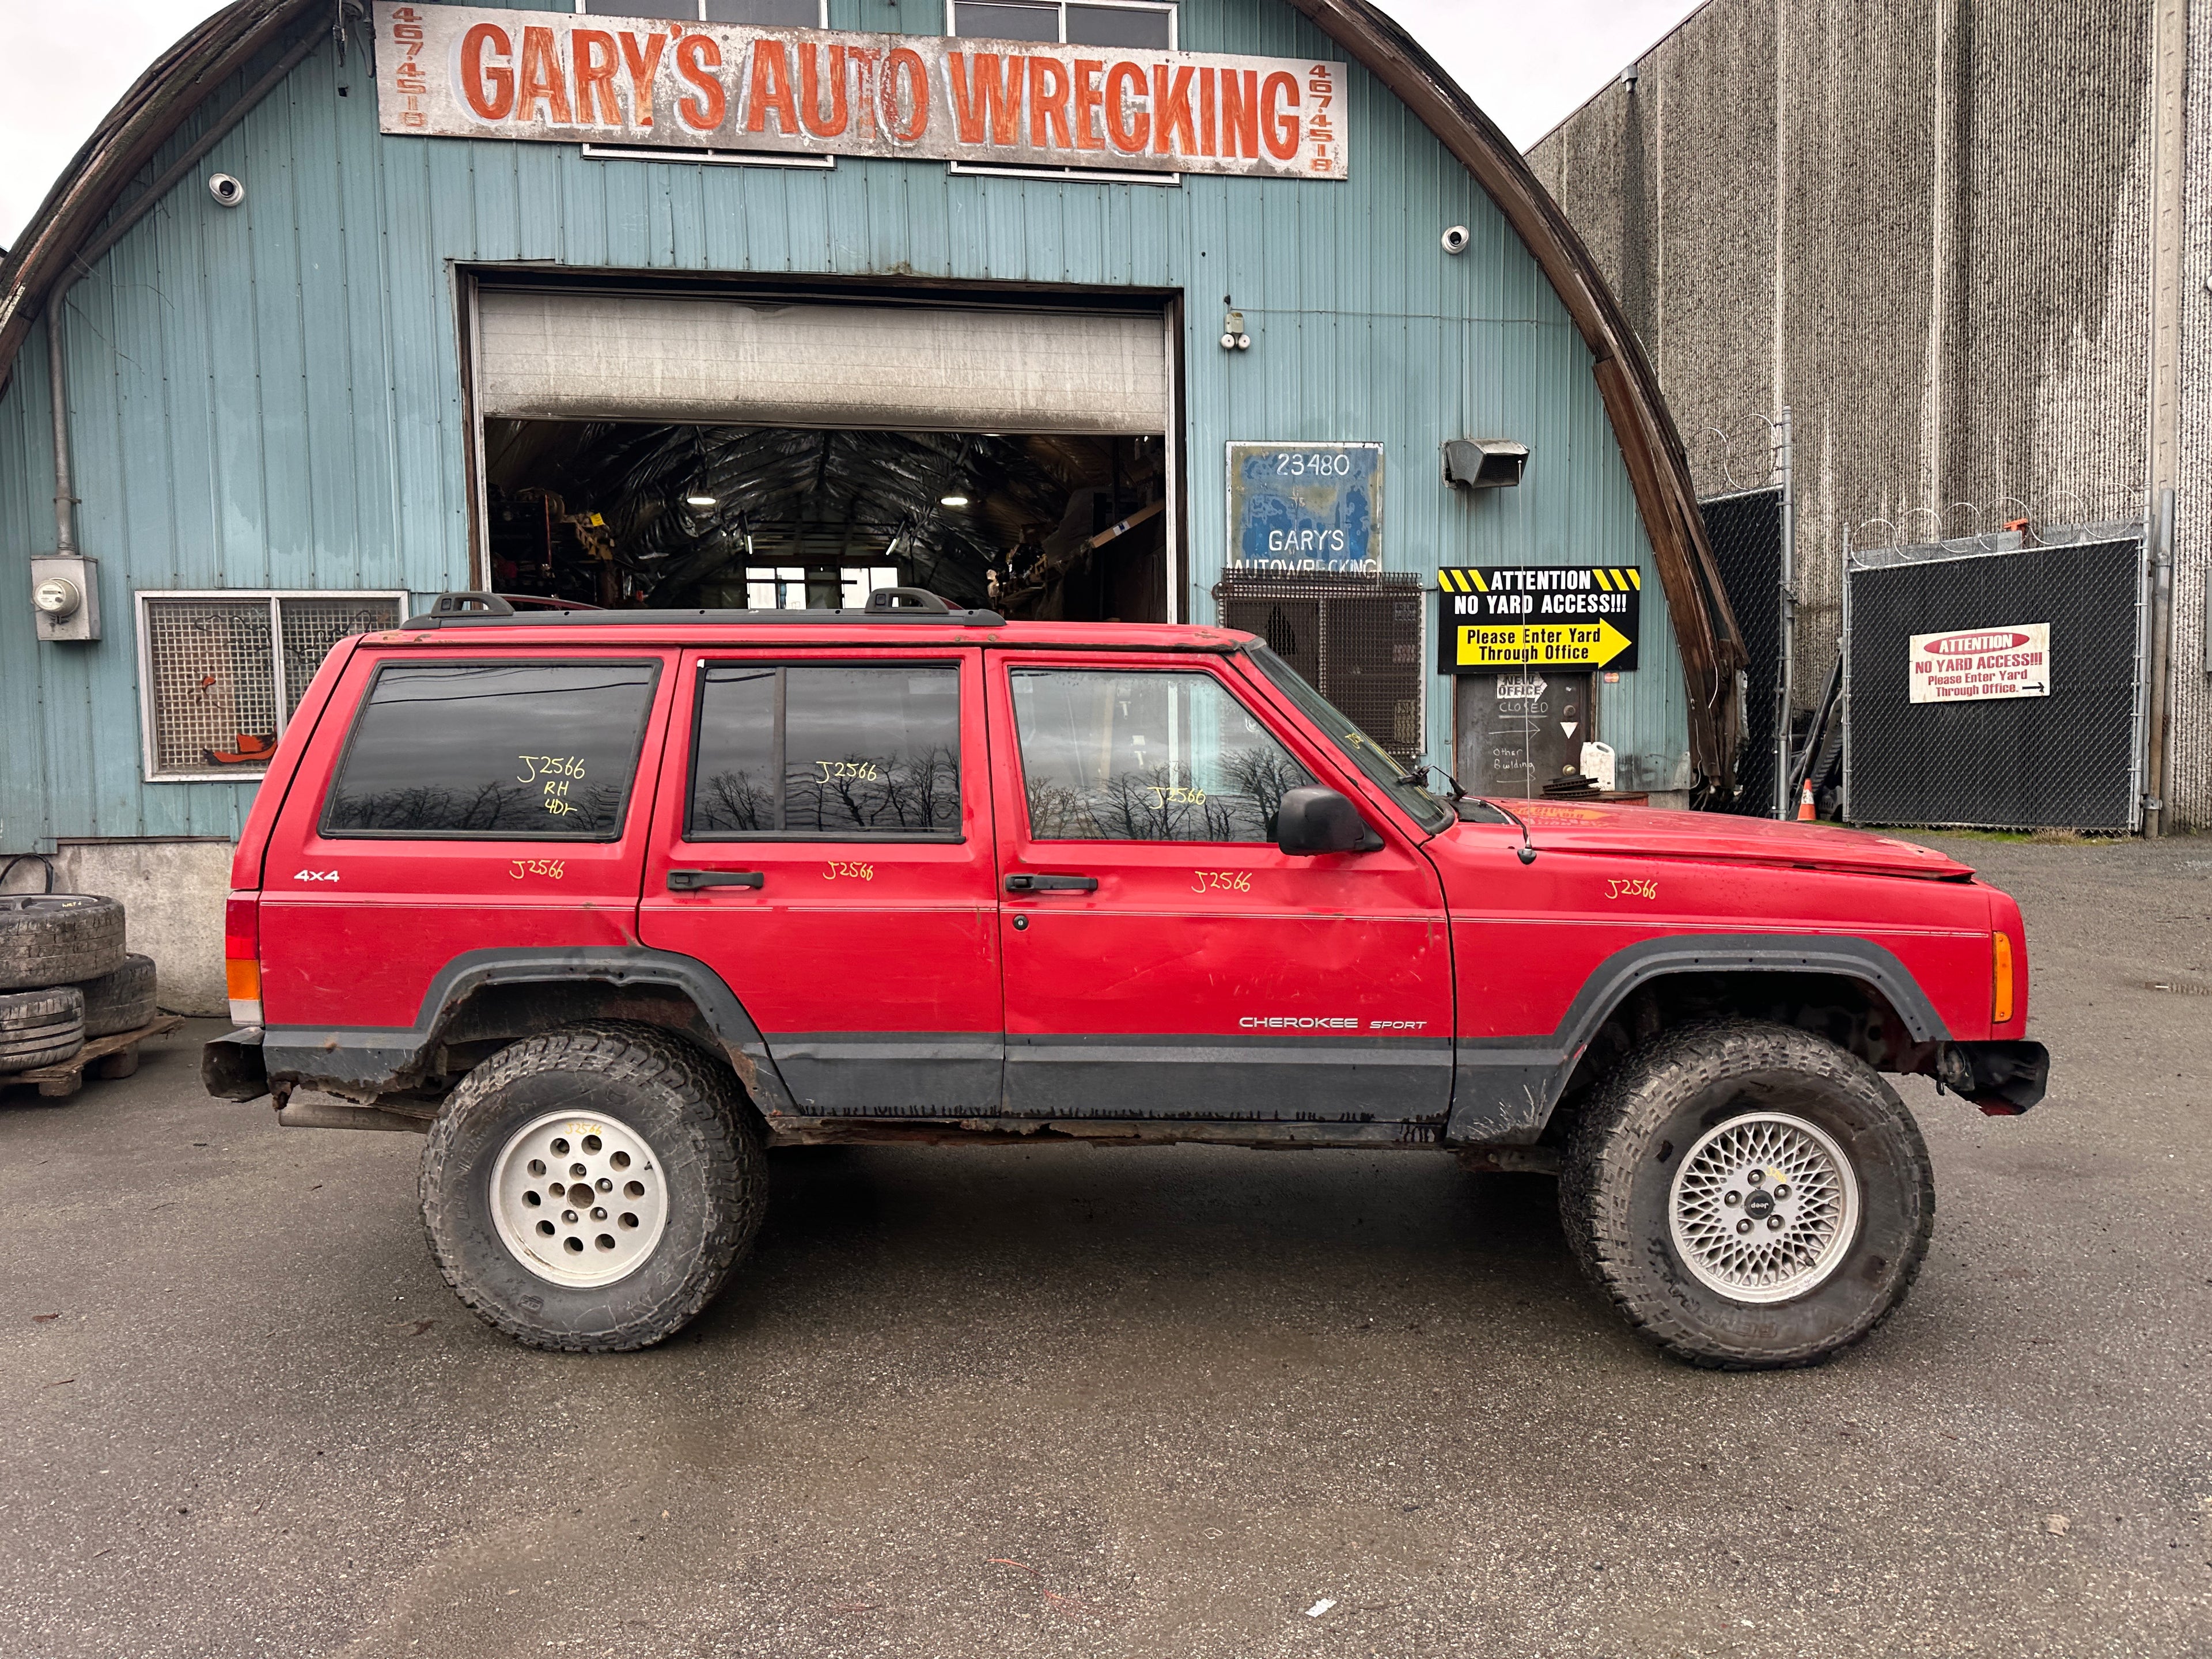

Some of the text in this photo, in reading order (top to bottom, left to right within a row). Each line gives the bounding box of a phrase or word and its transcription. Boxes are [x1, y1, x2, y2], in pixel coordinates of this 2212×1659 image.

[460, 22, 1300, 160] GARY'S AUTO WRECKING
[1276, 453, 1350, 475] 23480
[1268, 530, 1344, 551] GARY'S
[1491, 570, 1590, 590] ATTENTION
[1455, 594, 1626, 615] NO YARD ACCESS!!!
[1467, 628, 1601, 644] Please Enter Yard
[1939, 634, 2013, 653] ATTENTION
[1479, 645, 1588, 662] Through Office
[1915, 652, 2043, 674] NO YARD ACCESS!!!
[1504, 675, 1535, 685] NEW
[1928, 669, 2028, 685] Please Enter Yard
[1498, 685, 1541, 696] OFFICE
[1936, 683, 2018, 697] Through Office.
[1499, 702, 1548, 713] CLOSED
[1493, 748, 1522, 756] Other
[517, 756, 585, 783] J2566
[816, 761, 877, 783] J2566
[1494, 759, 1535, 774] Building
[544, 781, 569, 796] RH
[1146, 787, 1206, 809] J2566
[509, 859, 565, 879] J2566
[823, 861, 873, 881] J2566
[1191, 871, 1252, 893] J2566
[1604, 879, 1658, 899] J2566
[1239, 1017, 1427, 1029] CHEROKEE SPORT
[565, 1123, 602, 1135] J2566
